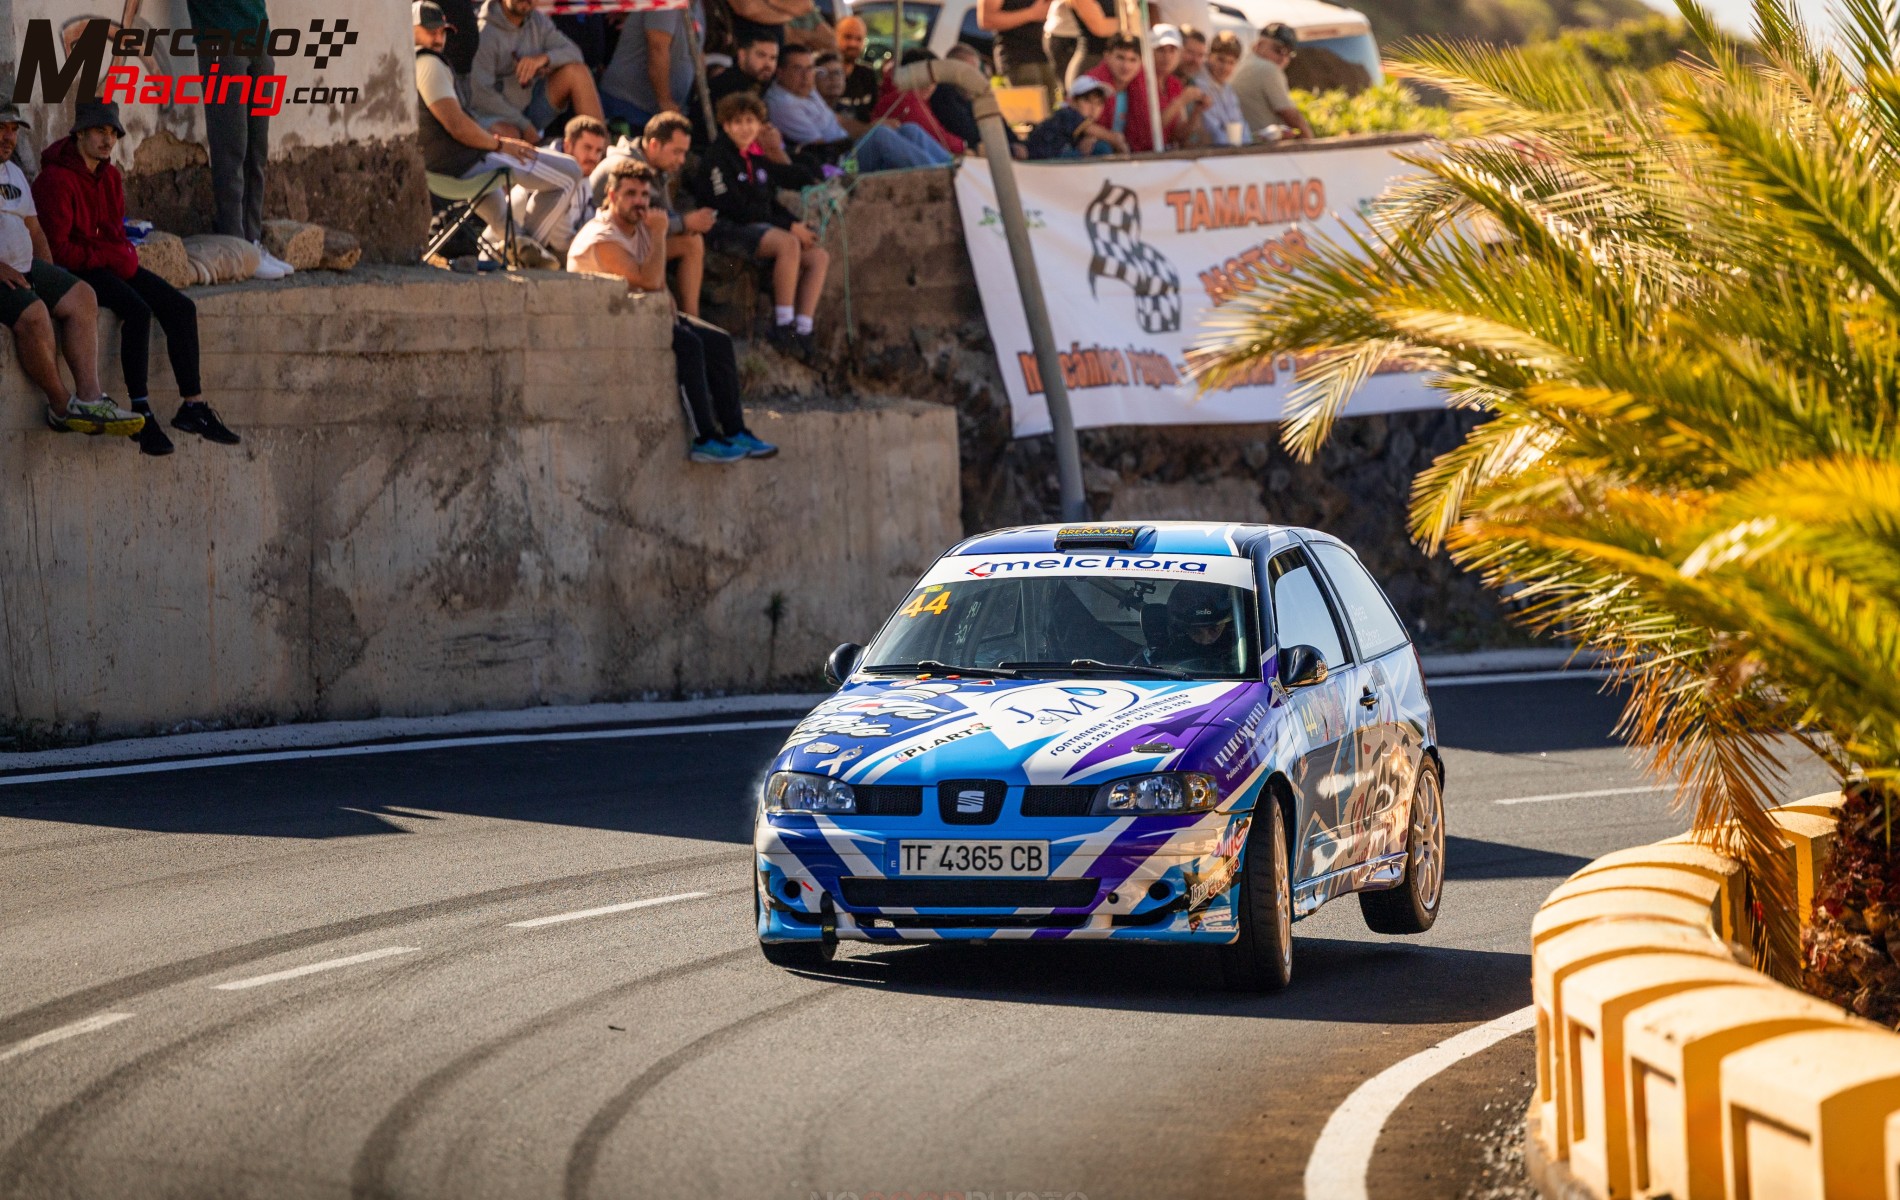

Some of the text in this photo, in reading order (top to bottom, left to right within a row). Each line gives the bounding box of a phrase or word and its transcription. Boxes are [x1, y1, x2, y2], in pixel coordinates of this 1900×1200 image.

[1165, 178, 1326, 232] TAMAIMO
[989, 556, 1208, 573] melchora
[899, 591, 952, 618] 44
[1301, 702, 1319, 738] 44
[1071, 741, 1093, 755] 666
[1091, 730, 1112, 742] 528
[890, 860, 897, 868] E
[901, 844, 1043, 872] TF 4365 CB
